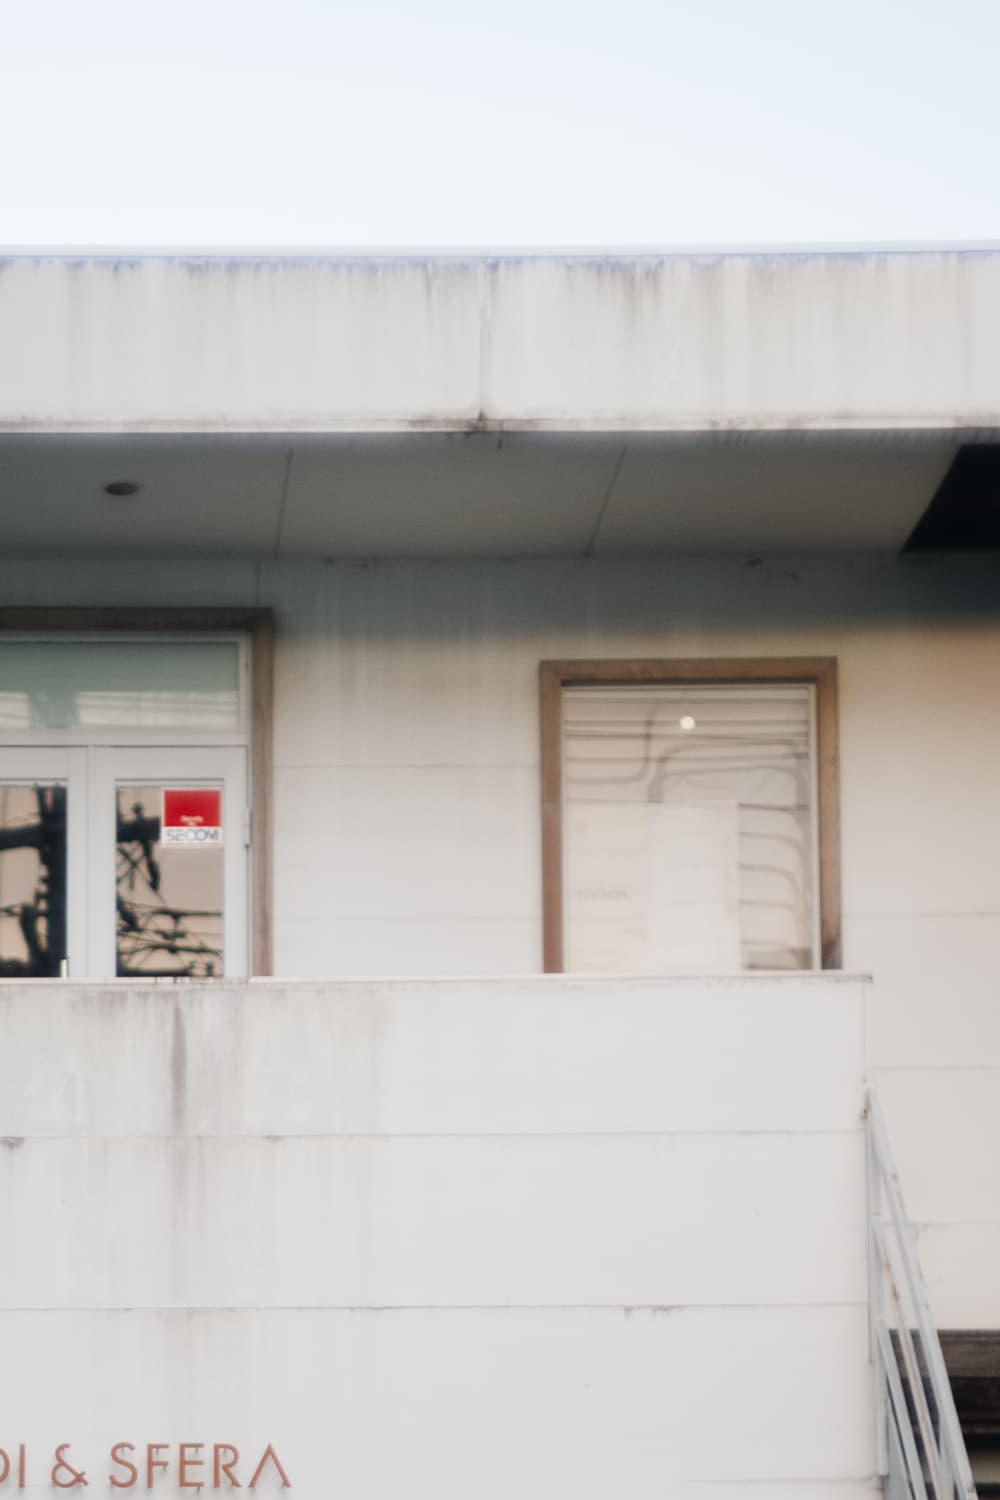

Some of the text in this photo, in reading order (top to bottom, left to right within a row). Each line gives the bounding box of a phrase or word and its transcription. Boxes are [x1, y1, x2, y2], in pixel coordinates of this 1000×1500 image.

[166, 829, 218, 841] SECOM
[51, 1443, 88, 1488] &
[108, 1441, 291, 1488] SFERA
